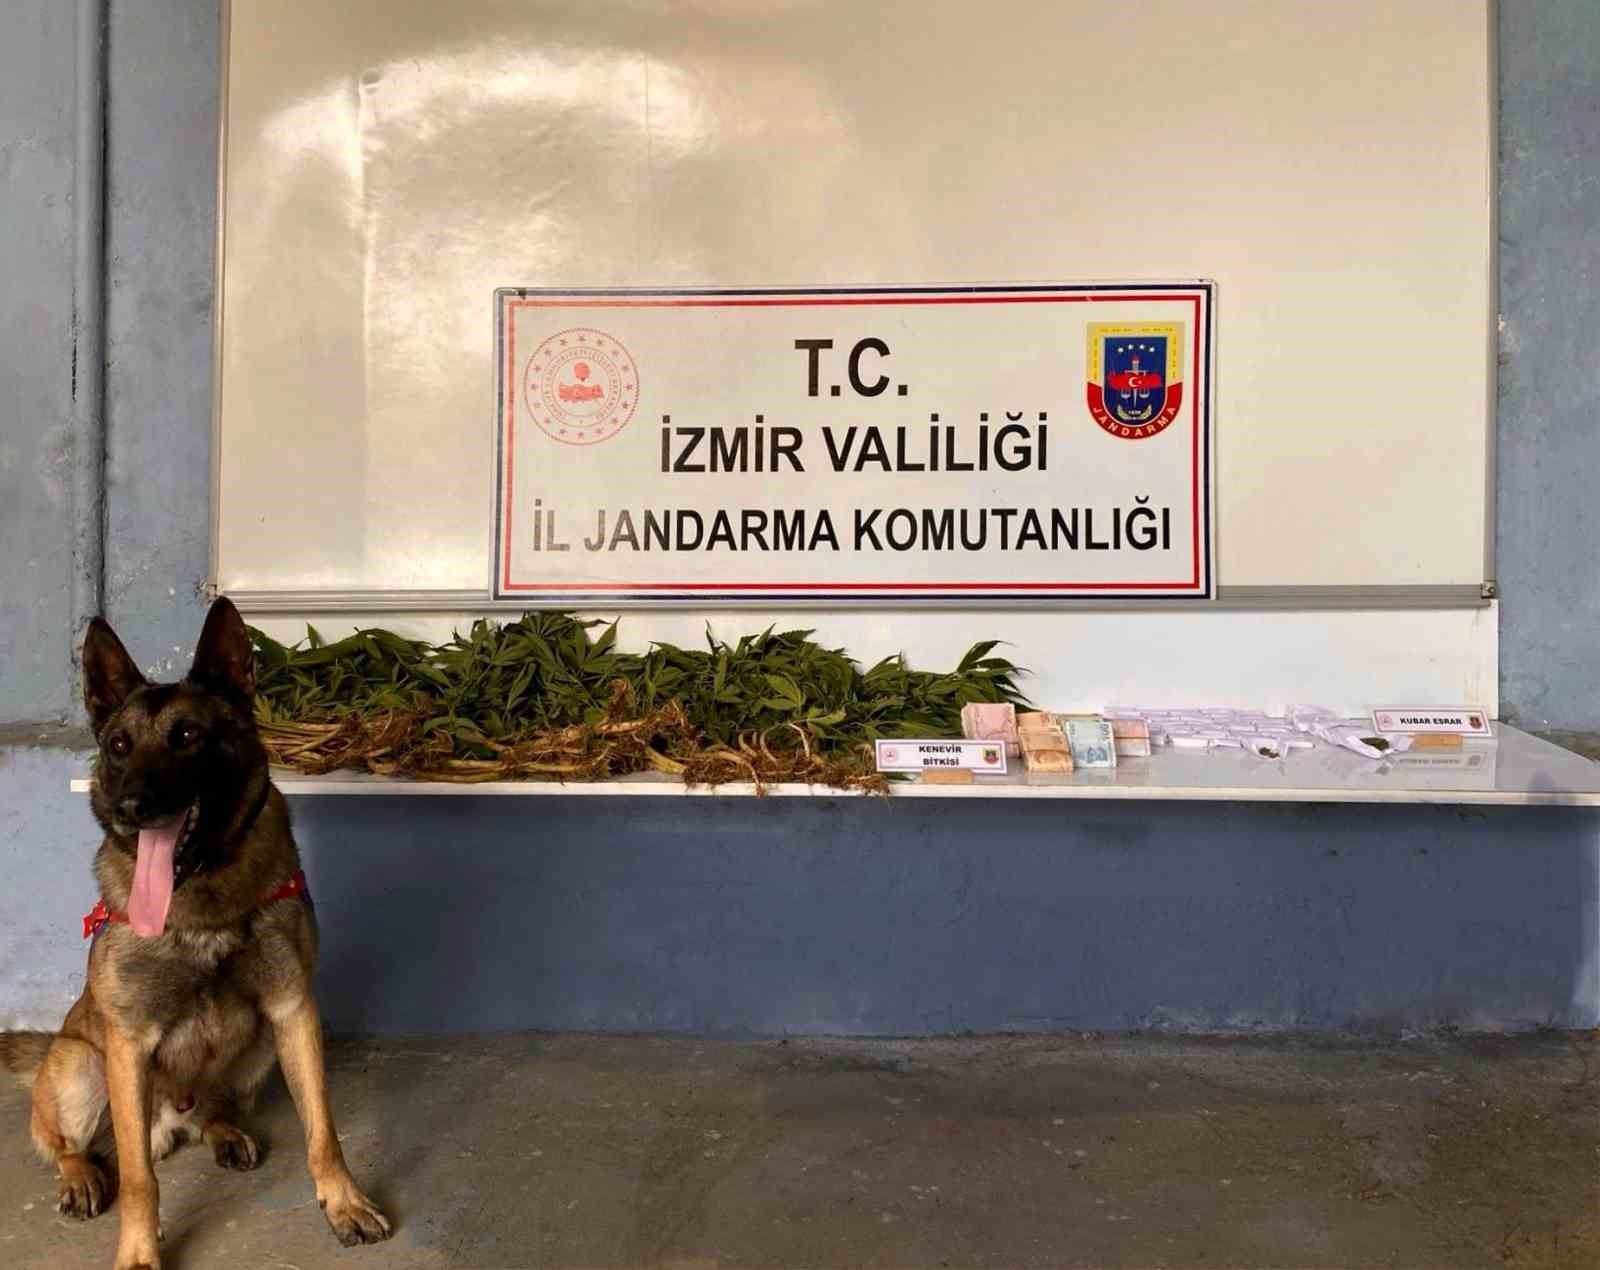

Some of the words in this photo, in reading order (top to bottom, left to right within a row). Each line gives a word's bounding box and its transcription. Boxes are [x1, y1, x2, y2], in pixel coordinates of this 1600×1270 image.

[794, 337, 908, 399] T.C.
[1093, 406, 1176, 437] JANDARMA
[661, 414, 805, 473] İZMİR
[821, 411, 1048, 472] VALİLİĞİ
[533, 498, 570, 552] İL
[584, 508, 841, 552] JANDARMA
[854, 495, 1171, 552] KOMUTANLIĞI
[1399, 717, 1431, 725] KUBAR
[1432, 717, 1462, 725] ESRAR
[919, 743, 962, 753] KENEVİR
[923, 757, 960, 766] BİTKİSİ
